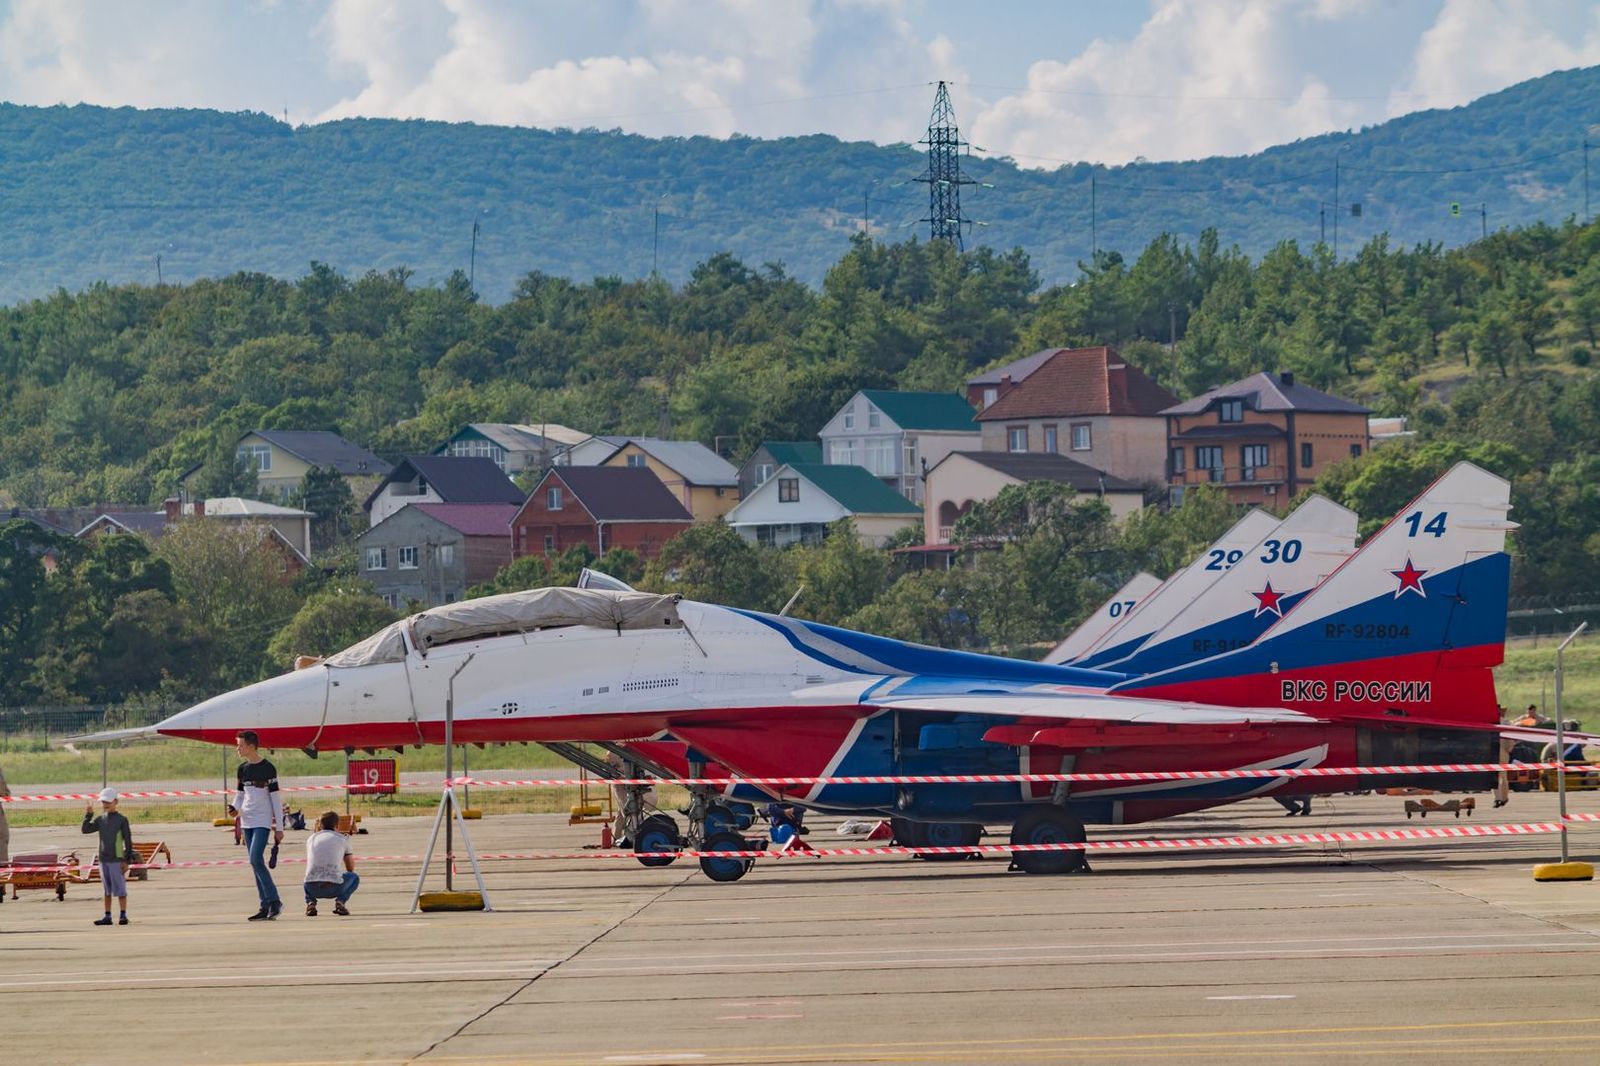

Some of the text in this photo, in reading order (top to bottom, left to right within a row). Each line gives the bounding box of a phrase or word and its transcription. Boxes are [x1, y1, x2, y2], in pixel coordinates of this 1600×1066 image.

[1405, 511, 1448, 538] 14
[1205, 549, 1243, 570] 29
[1260, 539, 1302, 564] 30
[1109, 601, 1136, 618] 07
[1326, 623, 1409, 639] RF-92804
[1280, 681, 1432, 702] ВКС РОССИИ
[363, 768, 379, 784] 19
